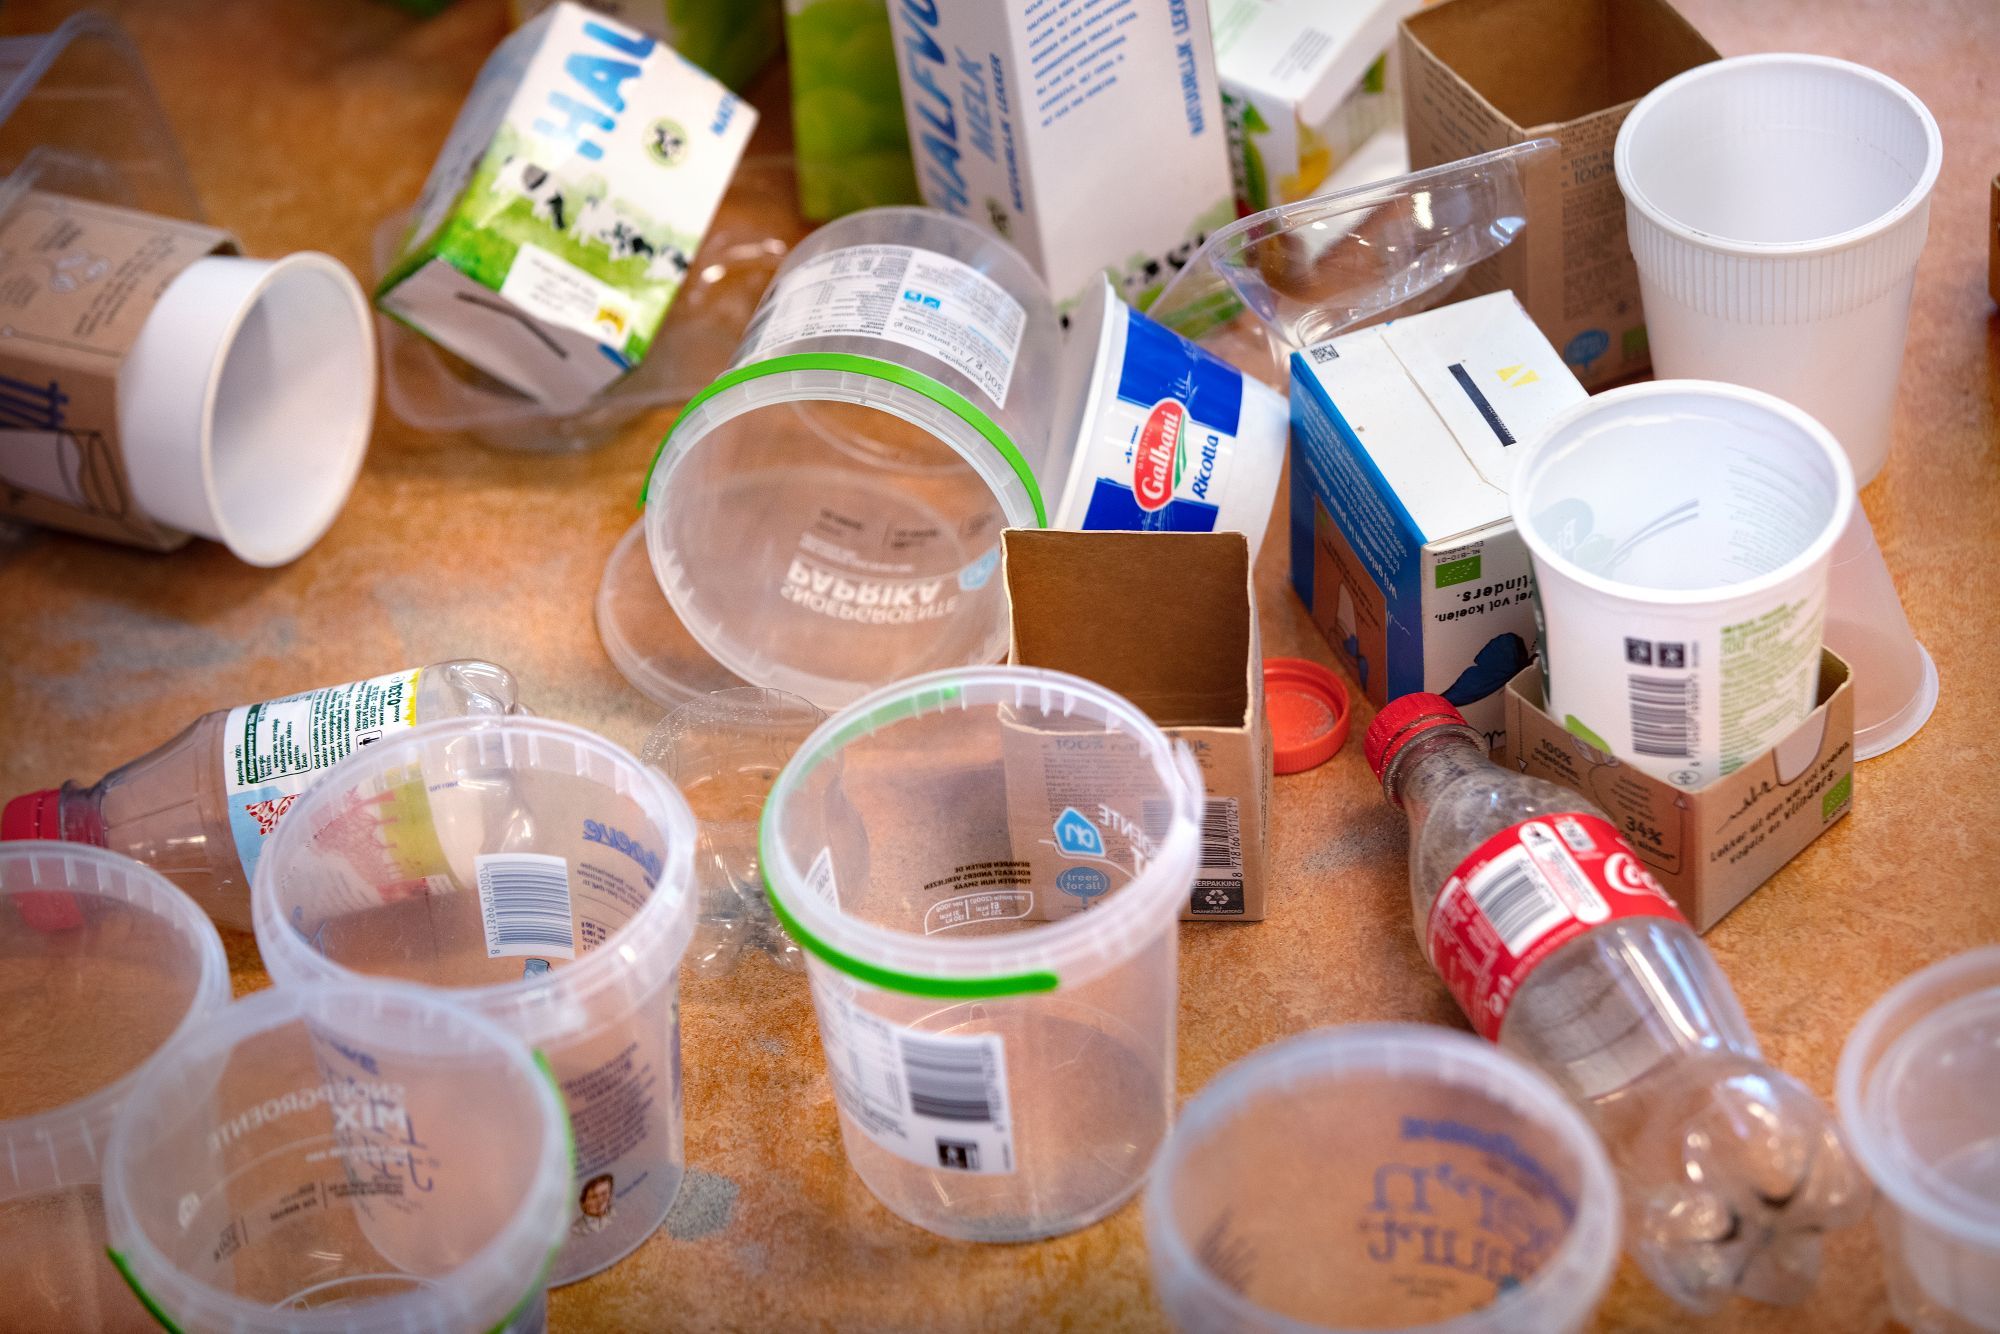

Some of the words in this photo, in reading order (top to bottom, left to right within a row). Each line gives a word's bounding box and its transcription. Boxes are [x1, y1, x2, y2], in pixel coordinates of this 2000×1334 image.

[955, 47, 996, 163] MELK
[985, 371, 1003, 394] 300
[1142, 411, 1178, 499] Galbani
[1192, 435, 1220, 499] Ricotta
[1456, 574, 1531, 604] linders.
[1489, 595, 1511, 612] vol
[1434, 602, 1486, 624] koeien,
[248, 733, 256, 780] Voedingswaarde
[1625, 815, 1662, 847] 34%
[1711, 830, 1745, 863] Lekker
[1749, 818, 1762, 833] uit
[1766, 803, 1782, 820] een
[1804, 771, 1817, 787] vol
[1730, 833, 1764, 864] vogels
[1767, 820, 1780, 834] en
[1066, 881, 1082, 892] for
[1083, 881, 1103, 892] all
[1067, 873, 1099, 884] trees
